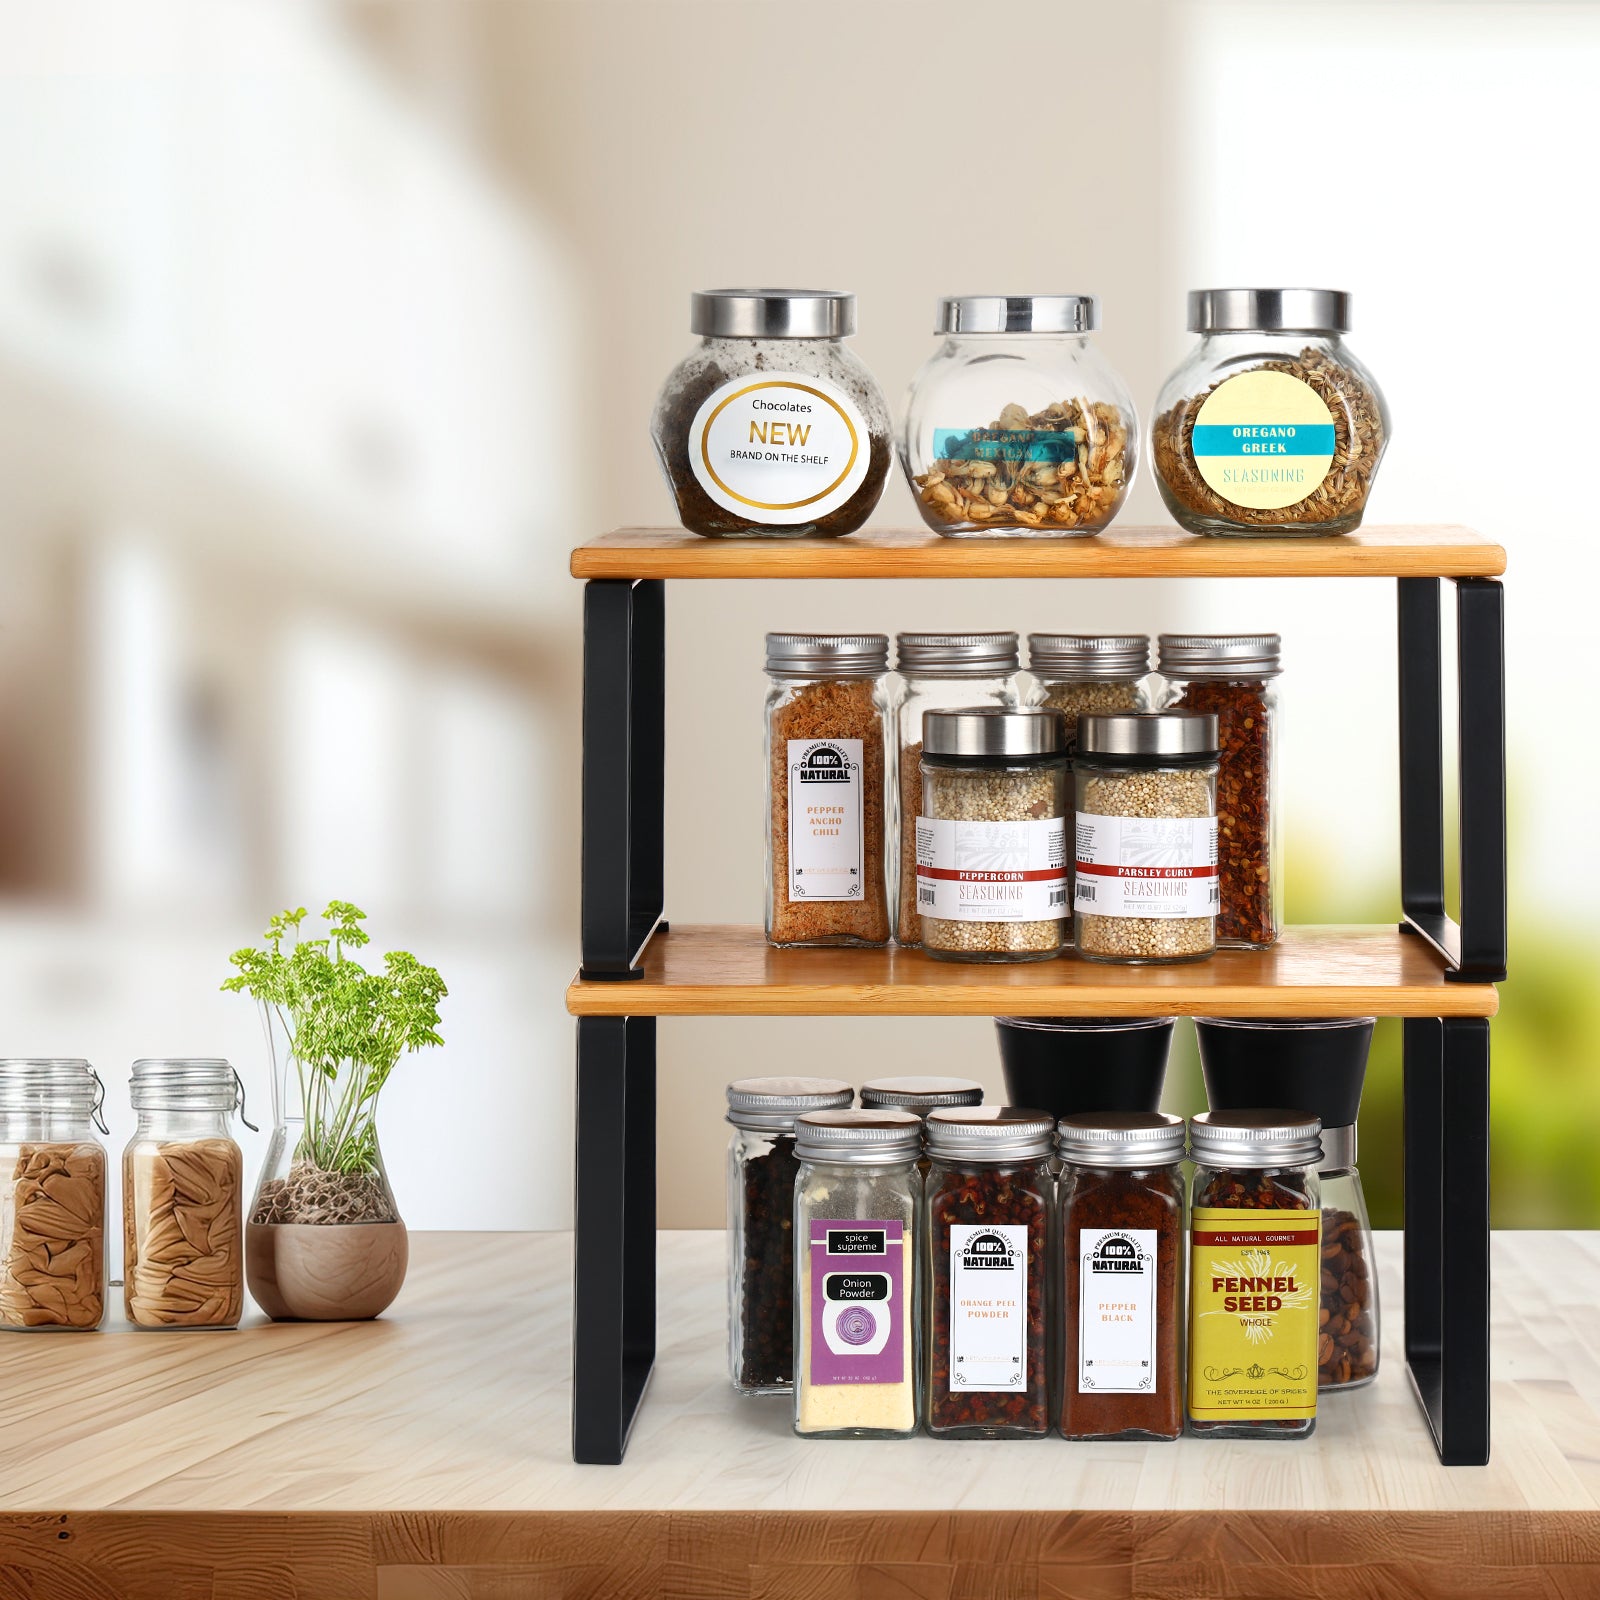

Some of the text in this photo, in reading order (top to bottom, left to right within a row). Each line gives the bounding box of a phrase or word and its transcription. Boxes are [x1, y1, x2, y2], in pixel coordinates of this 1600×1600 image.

[752, 399, 812, 413] Chocolates
[749, 420, 812, 447] NEW
[1232, 427, 1296, 438] OREGANO
[1242, 443, 1287, 453] GREEK
[730, 449, 829, 465] BRAND ON THE SHELF
[1223, 468, 1305, 483] SEASONING
[801, 741, 850, 762] PREMIUM QUALITY
[812, 755, 839, 765] 100%
[800, 769, 851, 780] NATURAL
[807, 806, 845, 814] PEPPER
[809, 817, 842, 825] ANCHO
[813, 828, 839, 836] CHILI
[959, 871, 1025, 881] PEPPERCORN
[1118, 867, 1194, 877] PARSLEY CURLY
[959, 885, 1023, 900] SEASONING
[1124, 881, 1188, 897] SEASONING
[845, 1233, 869, 1243] spice
[965, 1228, 1014, 1249] PREMIUM QUALITY
[1094, 1231, 1143, 1252] PREMIUM QUALITY
[837, 1243, 877, 1252] supreme
[975, 1242, 1002, 1252] 100%
[1105, 1245, 1132, 1255] 100%
[963, 1256, 1015, 1267] NATURAL
[1092, 1260, 1144, 1271] NATURAL
[843, 1279, 872, 1288] Onion
[1212, 1277, 1299, 1293] FENNEL
[840, 1289, 875, 1298] Powder
[1098, 1303, 1137, 1311] PEPPER
[1224, 1296, 1282, 1312] SEED
[967, 1310, 1010, 1319] POWDER
[1101, 1314, 1134, 1322] BLACK
[1240, 1318, 1272, 1327] WHOLE
